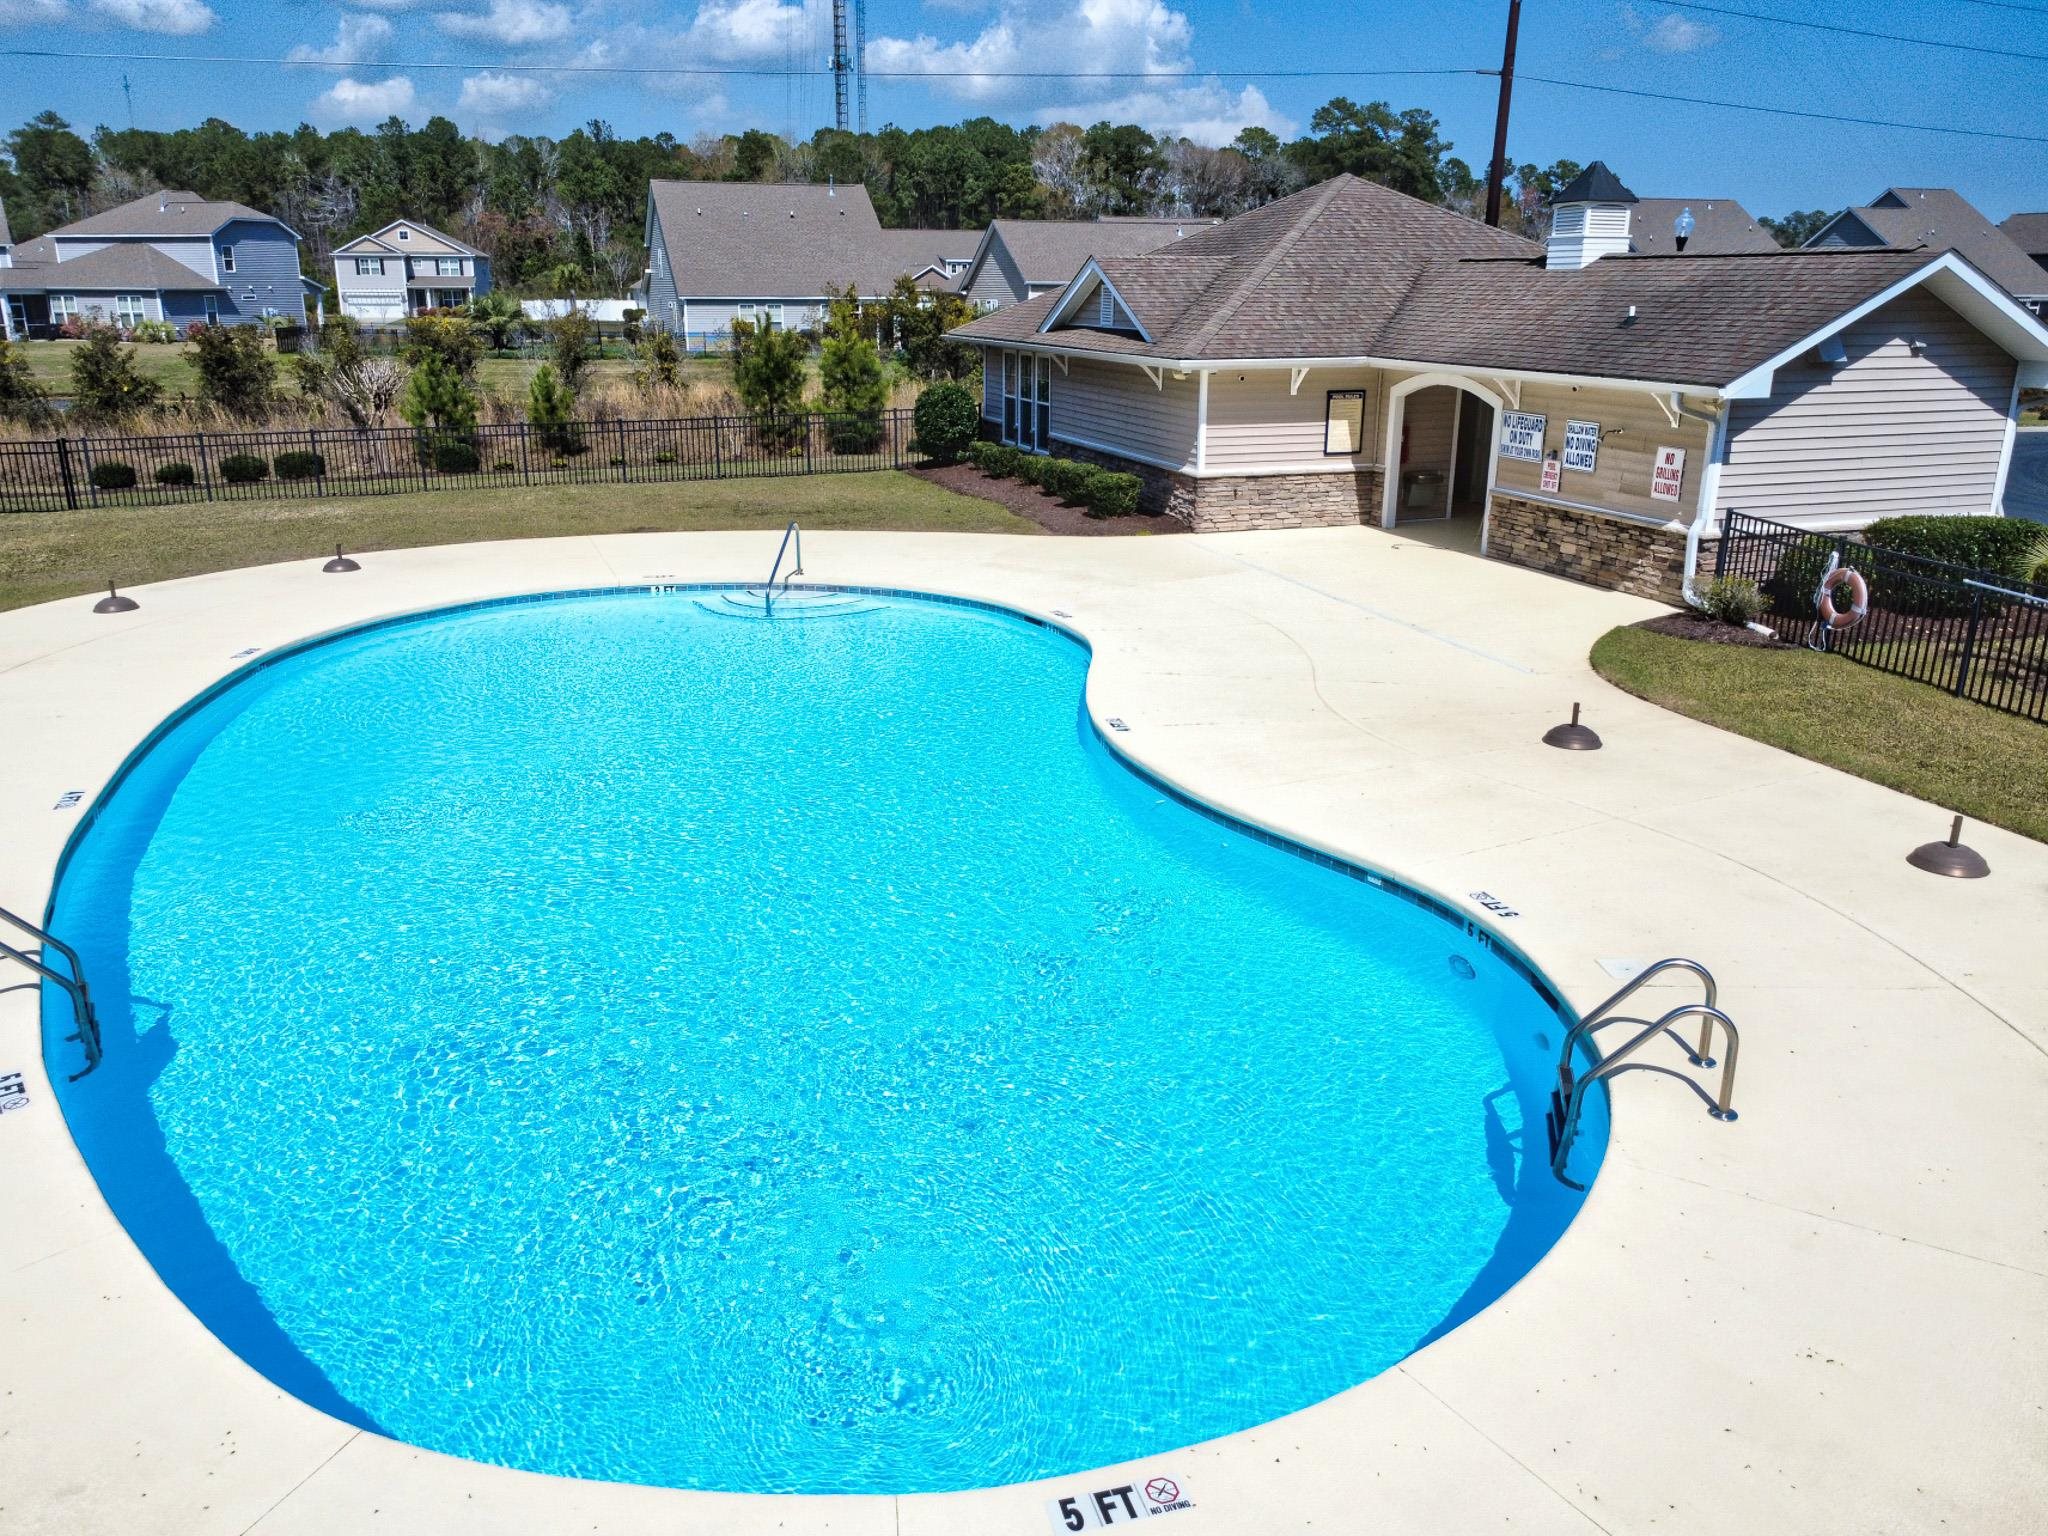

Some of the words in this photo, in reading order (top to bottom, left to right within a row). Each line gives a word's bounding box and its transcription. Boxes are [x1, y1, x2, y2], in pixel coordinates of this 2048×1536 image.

[1503, 414, 1511, 428] NO
[1512, 415, 1543, 432] LIFEGUARD
[1510, 430, 1517, 443] ON
[1519, 431, 1534, 446] DUTY
[1565, 436, 1574, 450] NO
[1575, 437, 1596, 453] DIVING
[1564, 451, 1593, 468] ALLOWED
[1665, 452, 1675, 465] NO
[1656, 466, 1679, 481] GRILLING
[1654, 481, 1677, 496] ALLOWED
[1058, 1497, 1085, 1532] 5
[1093, 1485, 1138, 1524] FT
[1150, 1506, 1162, 1515] NO
[1163, 1500, 1190, 1513] DIVING
